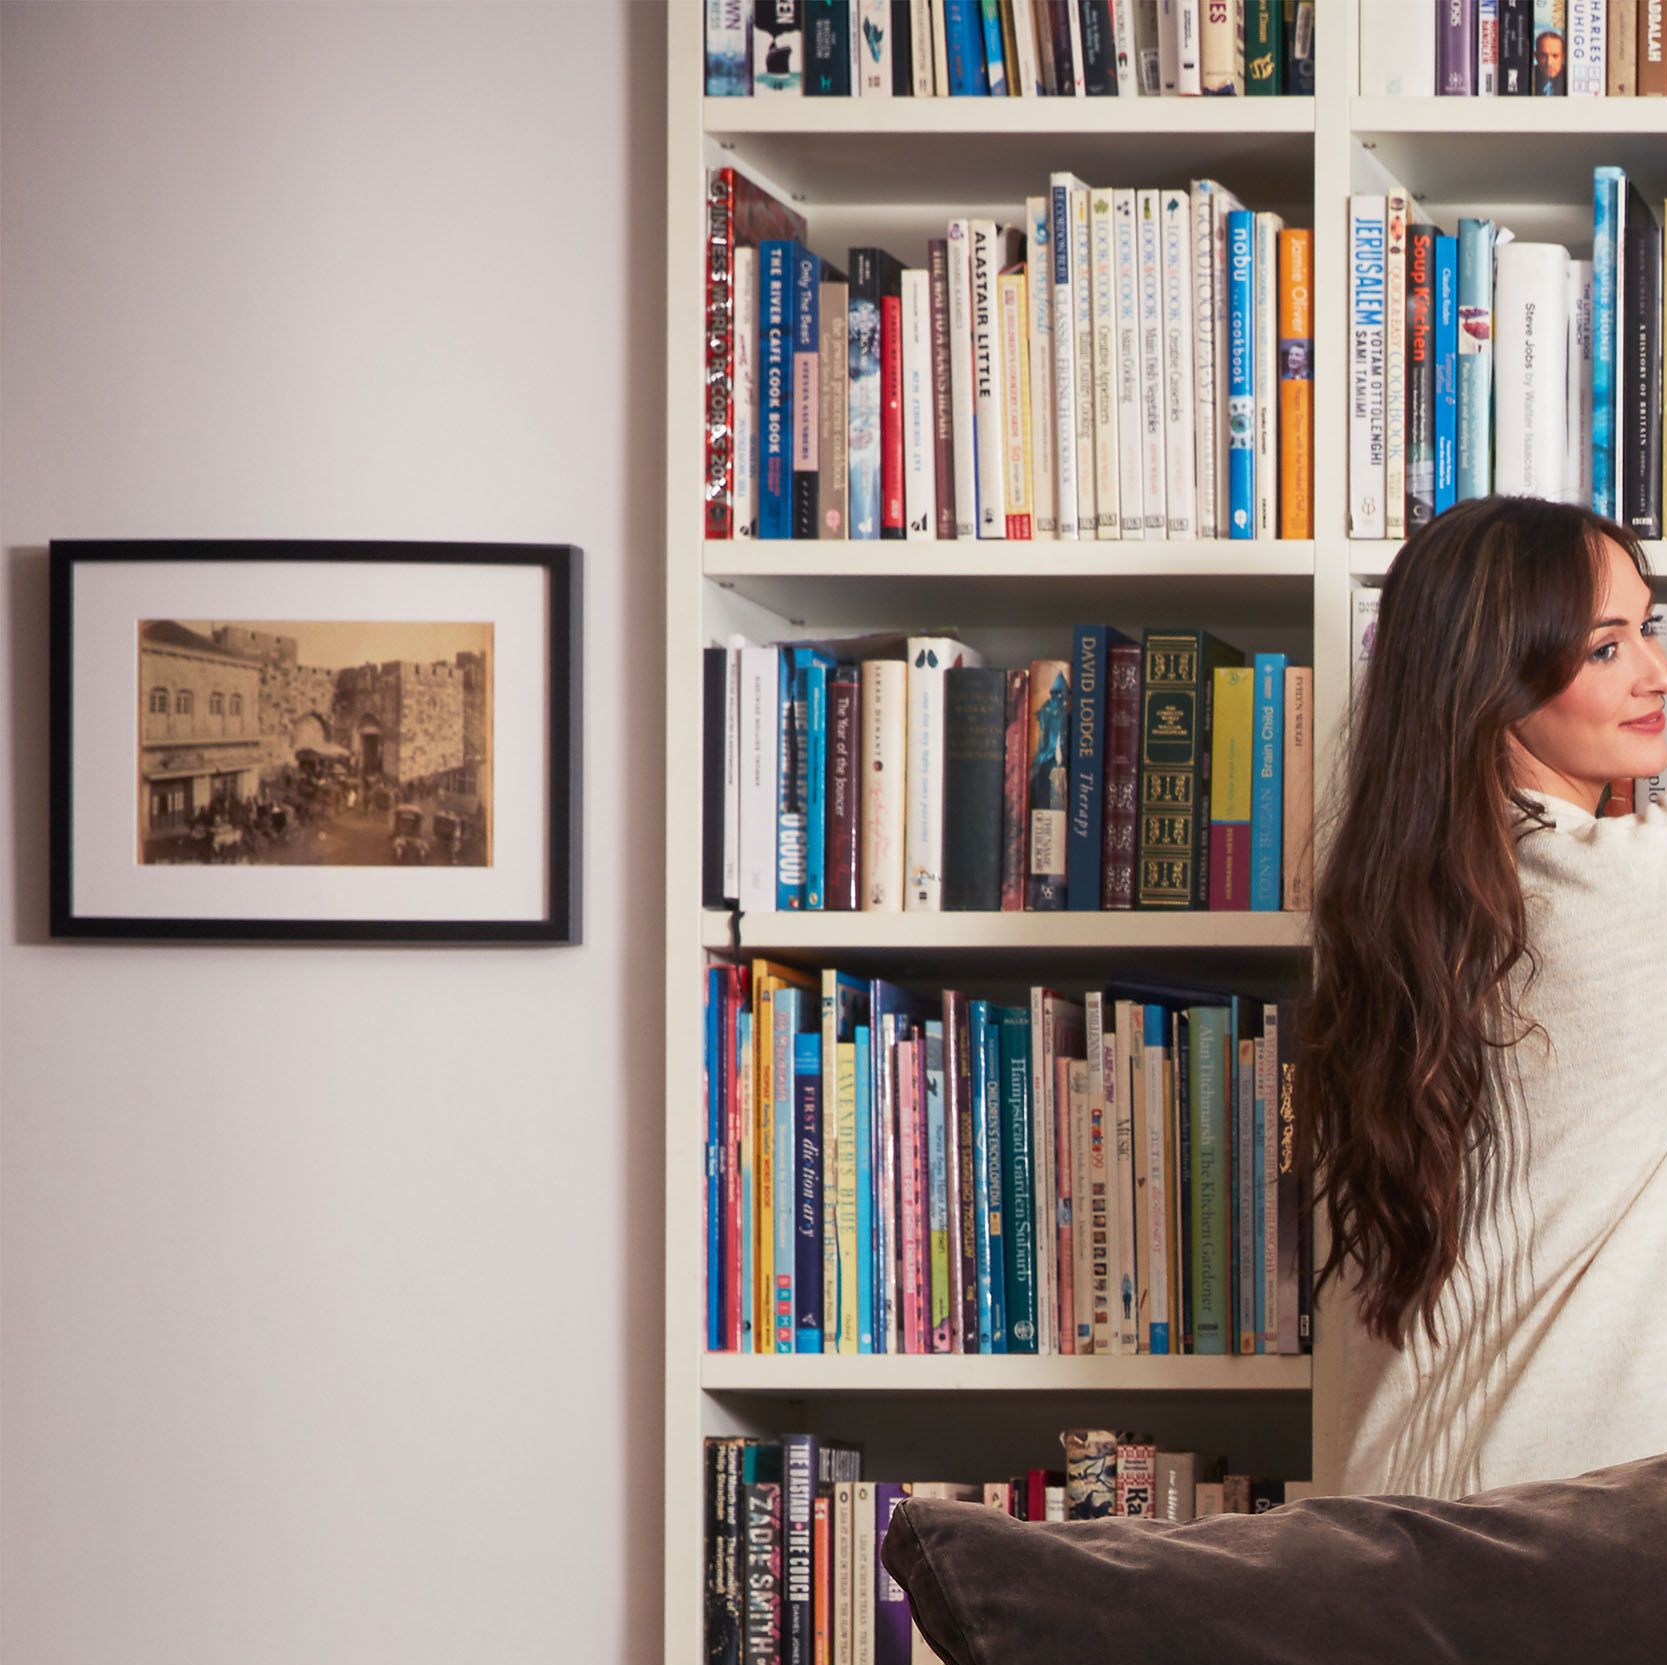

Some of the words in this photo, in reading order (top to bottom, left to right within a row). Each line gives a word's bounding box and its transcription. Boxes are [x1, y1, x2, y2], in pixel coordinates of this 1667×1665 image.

[770, 248, 781, 275] THE
[976, 232, 989, 325] ALASTAIR
[1233, 228, 1251, 281] nobu
[1290, 238, 1306, 281] Jamie
[1355, 218, 1382, 325] JERUSALEM
[1412, 235, 1429, 283] Soup
[770, 280, 781, 323] RIVER
[1290, 287, 1307, 333] Oliver
[1413, 287, 1429, 360] Kitchen
[1524, 303, 1535, 335] Steve
[770, 329, 781, 362] CAFE
[978, 334, 990, 398] LITTLE
[1232, 311, 1245, 384] cookbook
[1356, 331, 1367, 363] SAMI
[1371, 331, 1382, 375] YOTAM
[1524, 340, 1535, 368] Jobs
[769, 368, 781, 408] COOK
[1355, 370, 1367, 418] TAMIMI
[1522, 372, 1534, 387] by
[769, 413, 781, 453] BOOK
[1371, 381, 1382, 466] OTTOLENGHI
[1524, 391, 1535, 428] Walter
[1524, 432, 1534, 487] Isaacson
[1081, 637, 1096, 691] DAVID
[1079, 699, 1094, 757] LODGE
[1076, 773, 1093, 837] Therapy
[1200, 1024, 1213, 1061] Alan
[1009, 1058, 1026, 1152] Hampstead
[1201, 1064, 1214, 1145] Titchmarsh
[1013, 1156, 1029, 1218] Garden
[1201, 1148, 1214, 1177] The
[1201, 1181, 1215, 1239] Kitchen
[1015, 1222, 1029, 1281] Suburb
[1201, 1242, 1215, 1312] Gardener
[749, 1498, 772, 1567] ZADIE
[749, 1574, 773, 1653] SMITH
